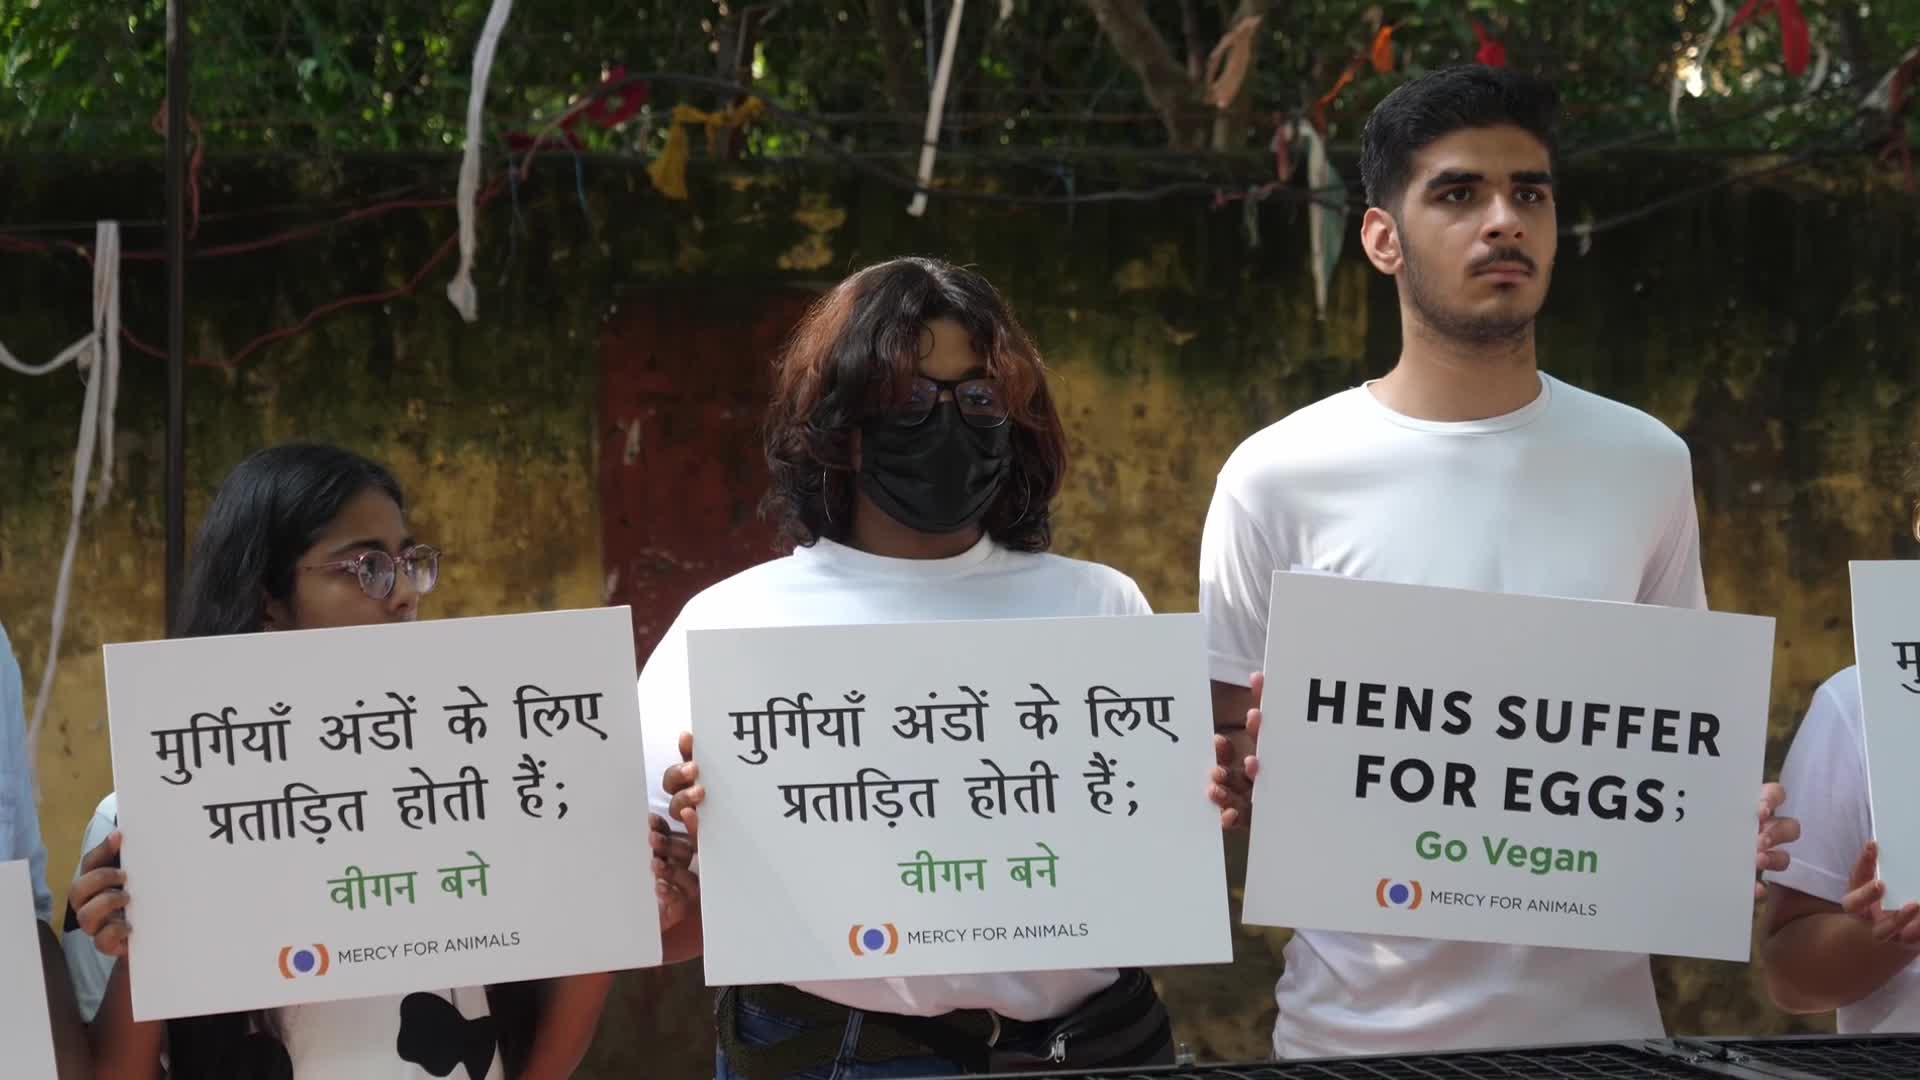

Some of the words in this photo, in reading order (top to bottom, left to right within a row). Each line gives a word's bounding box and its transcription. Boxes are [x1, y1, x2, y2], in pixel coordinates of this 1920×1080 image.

[319, 692, 418, 755] अंडों
[442, 686, 488, 744] के
[512, 685, 608, 741] लिए
[892, 686, 990, 744] अंडों
[1014, 683, 1061, 740] के
[1084, 685, 1179, 743] लिए
[1307, 678, 1472, 735] HENS
[1496, 695, 1720, 757] SUFFER
[392, 765, 489, 830] होती
[963, 758, 1060, 819] होती
[1355, 754, 1476, 808] FOR
[327, 865, 418, 911] वीगन
[437, 851, 490, 899] बने
[897, 850, 987, 894] वीगन
[1007, 842, 1059, 888] बने
[1416, 831, 1467, 862] Go
[1482, 836, 1597, 875] Vegan
[1431, 891, 1485, 907] MERCY
[1490, 896, 1522, 910] FOR
[1527, 899, 1597, 916] ANIMALS
[338, 944, 398, 964] MERCY
[404, 941, 439, 957] FOR
[445, 932, 520, 952] ANIMALS
[908, 929, 967, 944] MERCY
[973, 927, 1007, 941] FOR
[1013, 923, 1088, 939] ANIMALS
